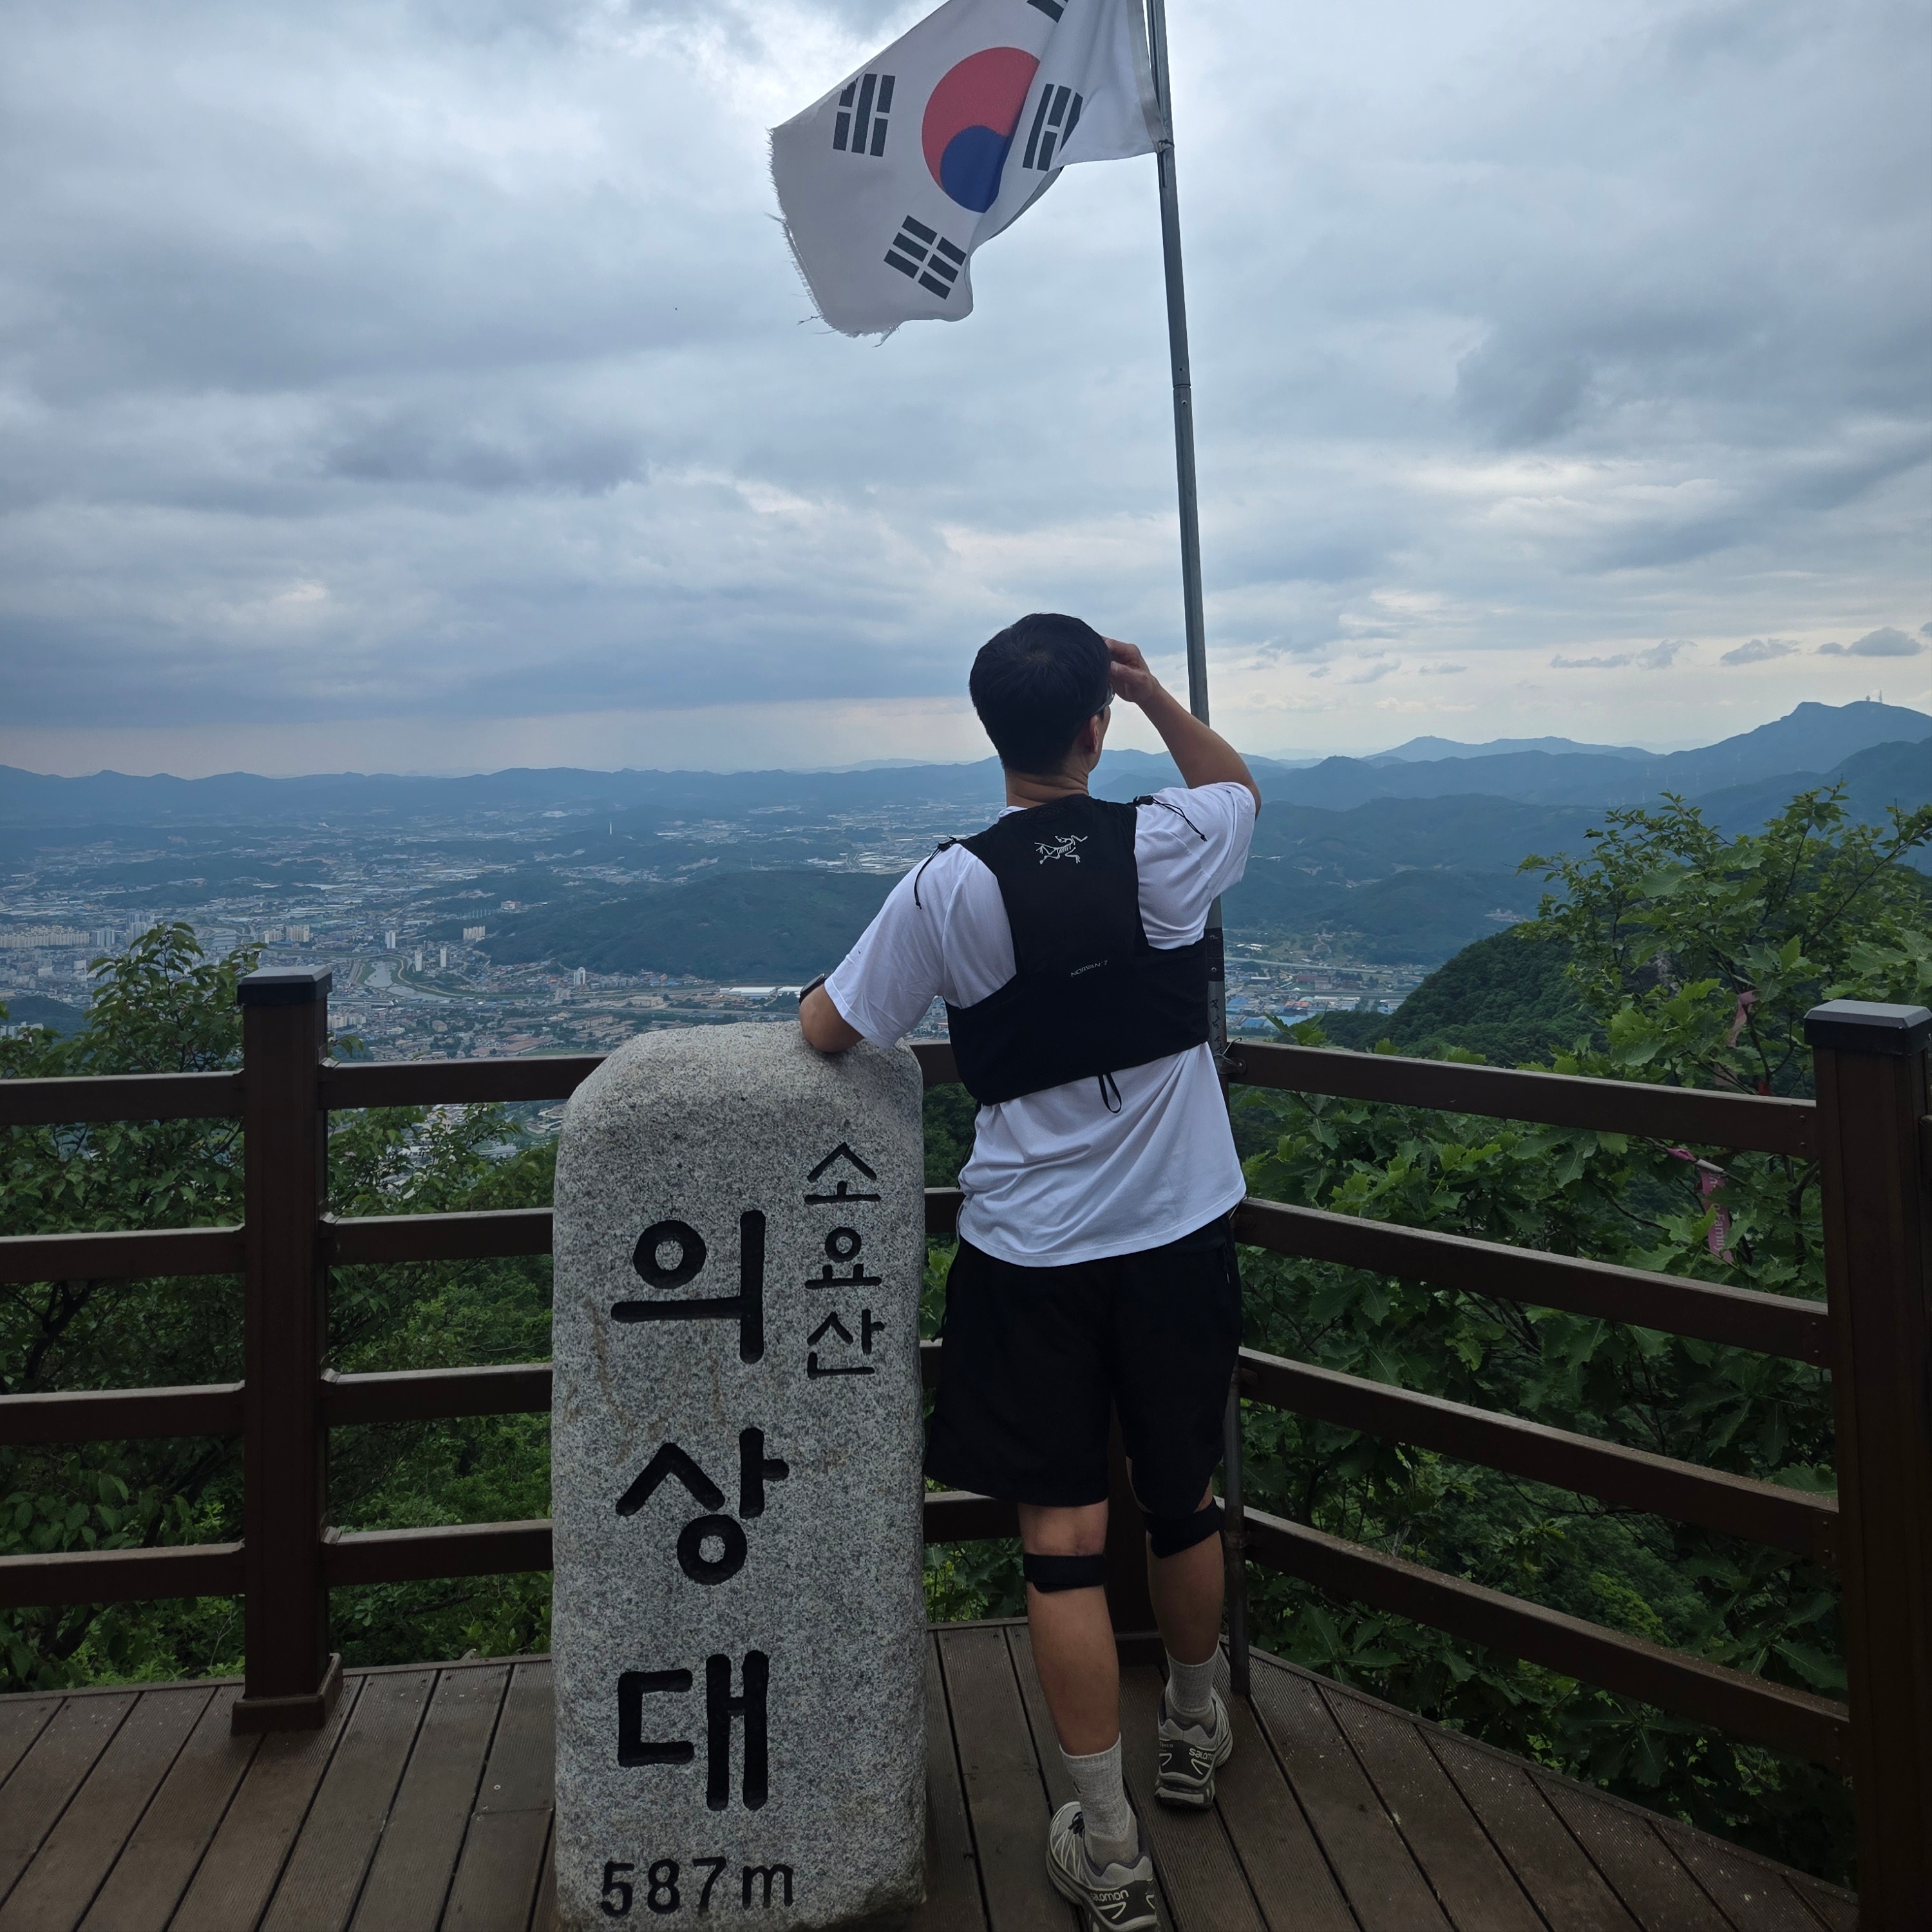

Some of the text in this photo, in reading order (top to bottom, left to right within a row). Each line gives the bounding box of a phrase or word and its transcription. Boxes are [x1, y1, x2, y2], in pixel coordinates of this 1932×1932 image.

[1070, 962, 1101, 977] NORVAN
[805, 1142, 886, 1379] 소요산
[611, 1209, 790, 1811] 의상대
[600, 1856, 794, 1917] 587m
